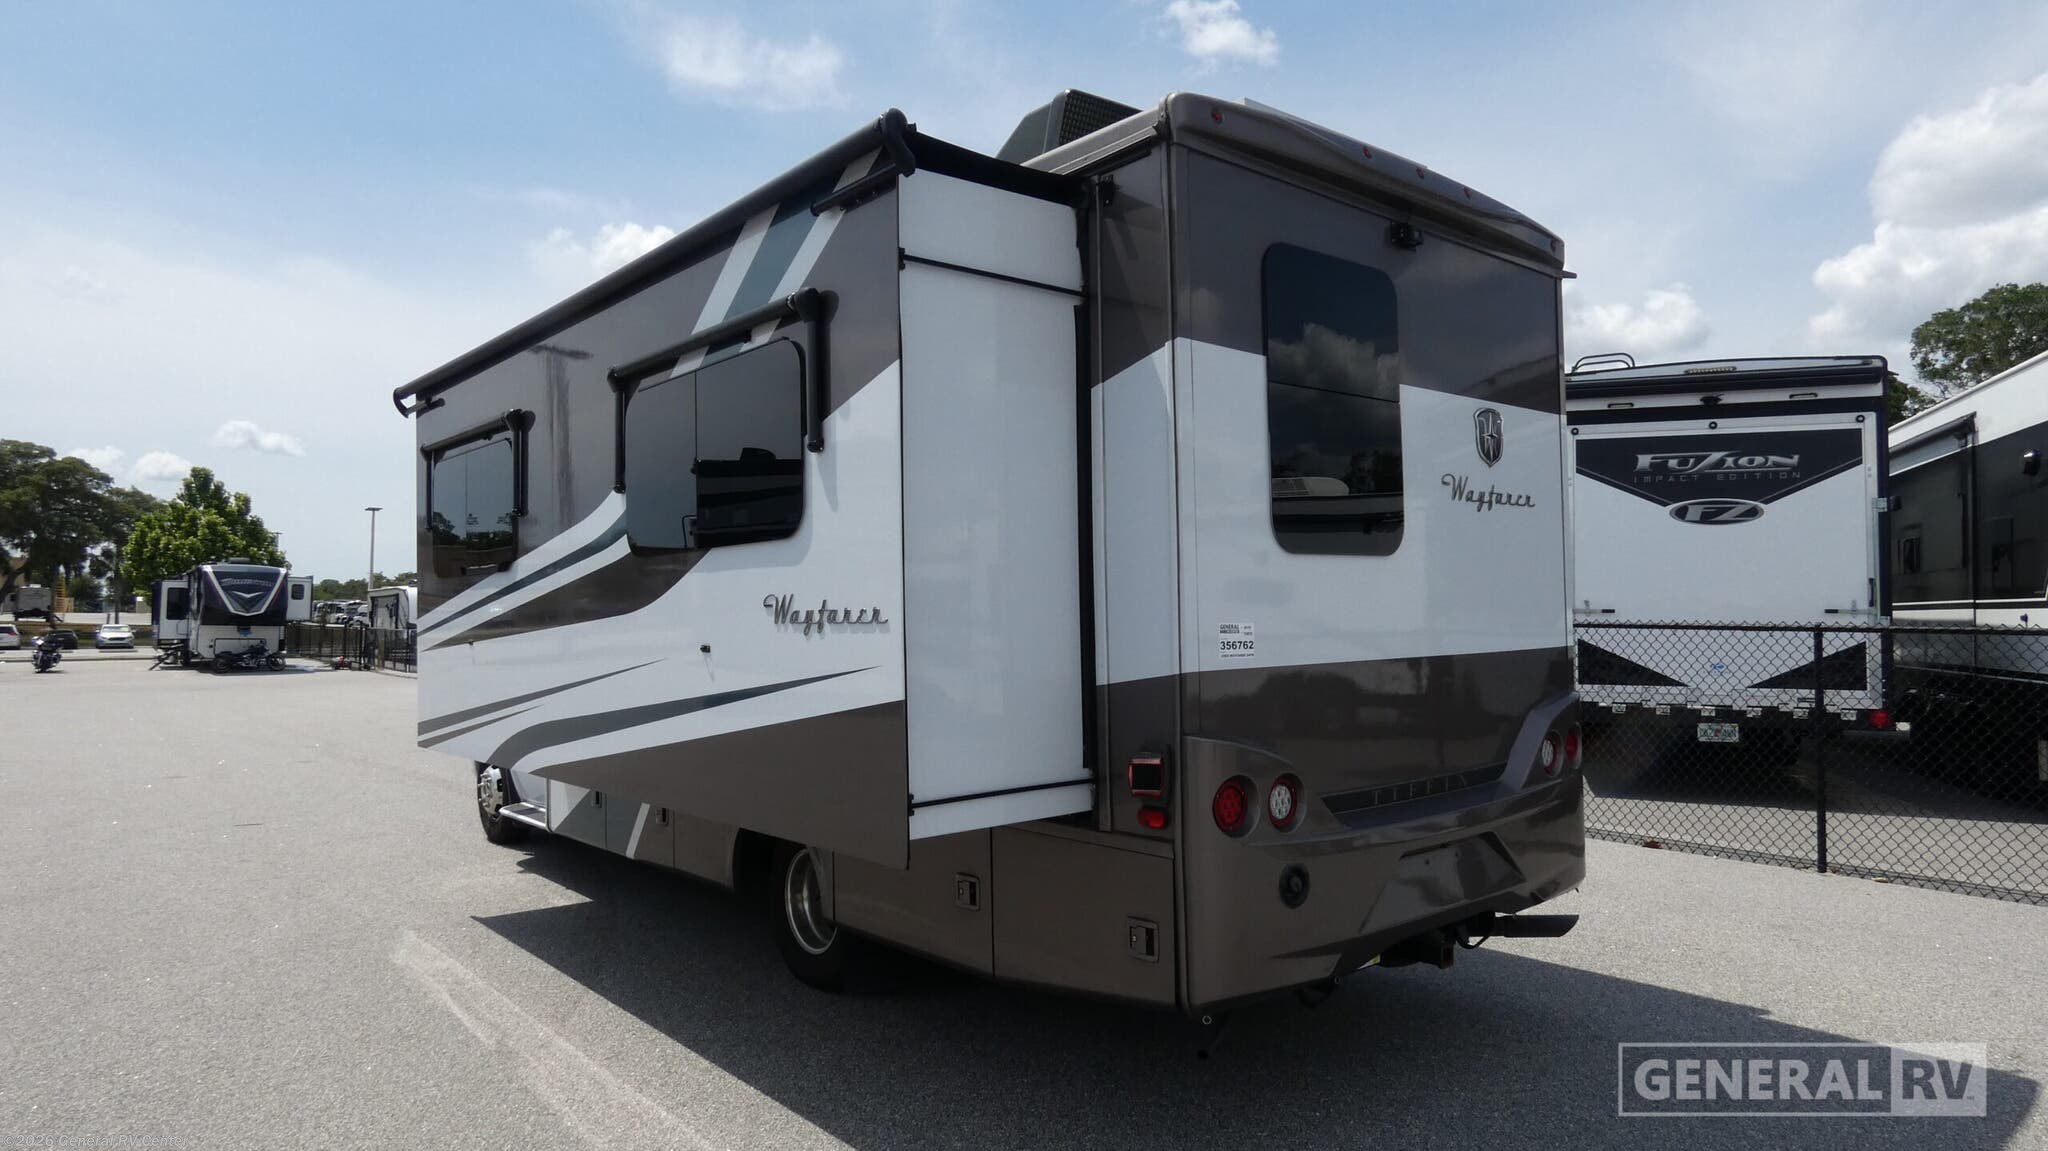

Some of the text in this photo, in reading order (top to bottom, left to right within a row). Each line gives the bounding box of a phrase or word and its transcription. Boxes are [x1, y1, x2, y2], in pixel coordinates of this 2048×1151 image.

[1633, 471, 1800, 484] IMPACT EDITION
[1441, 473, 1536, 512] Wayfarer
[1684, 504, 1757, 521] FZ
[762, 593, 889, 636] Wayfarer
[1220, 640, 1254, 650] 356762
[1372, 774, 1468, 805] TIFFIN
